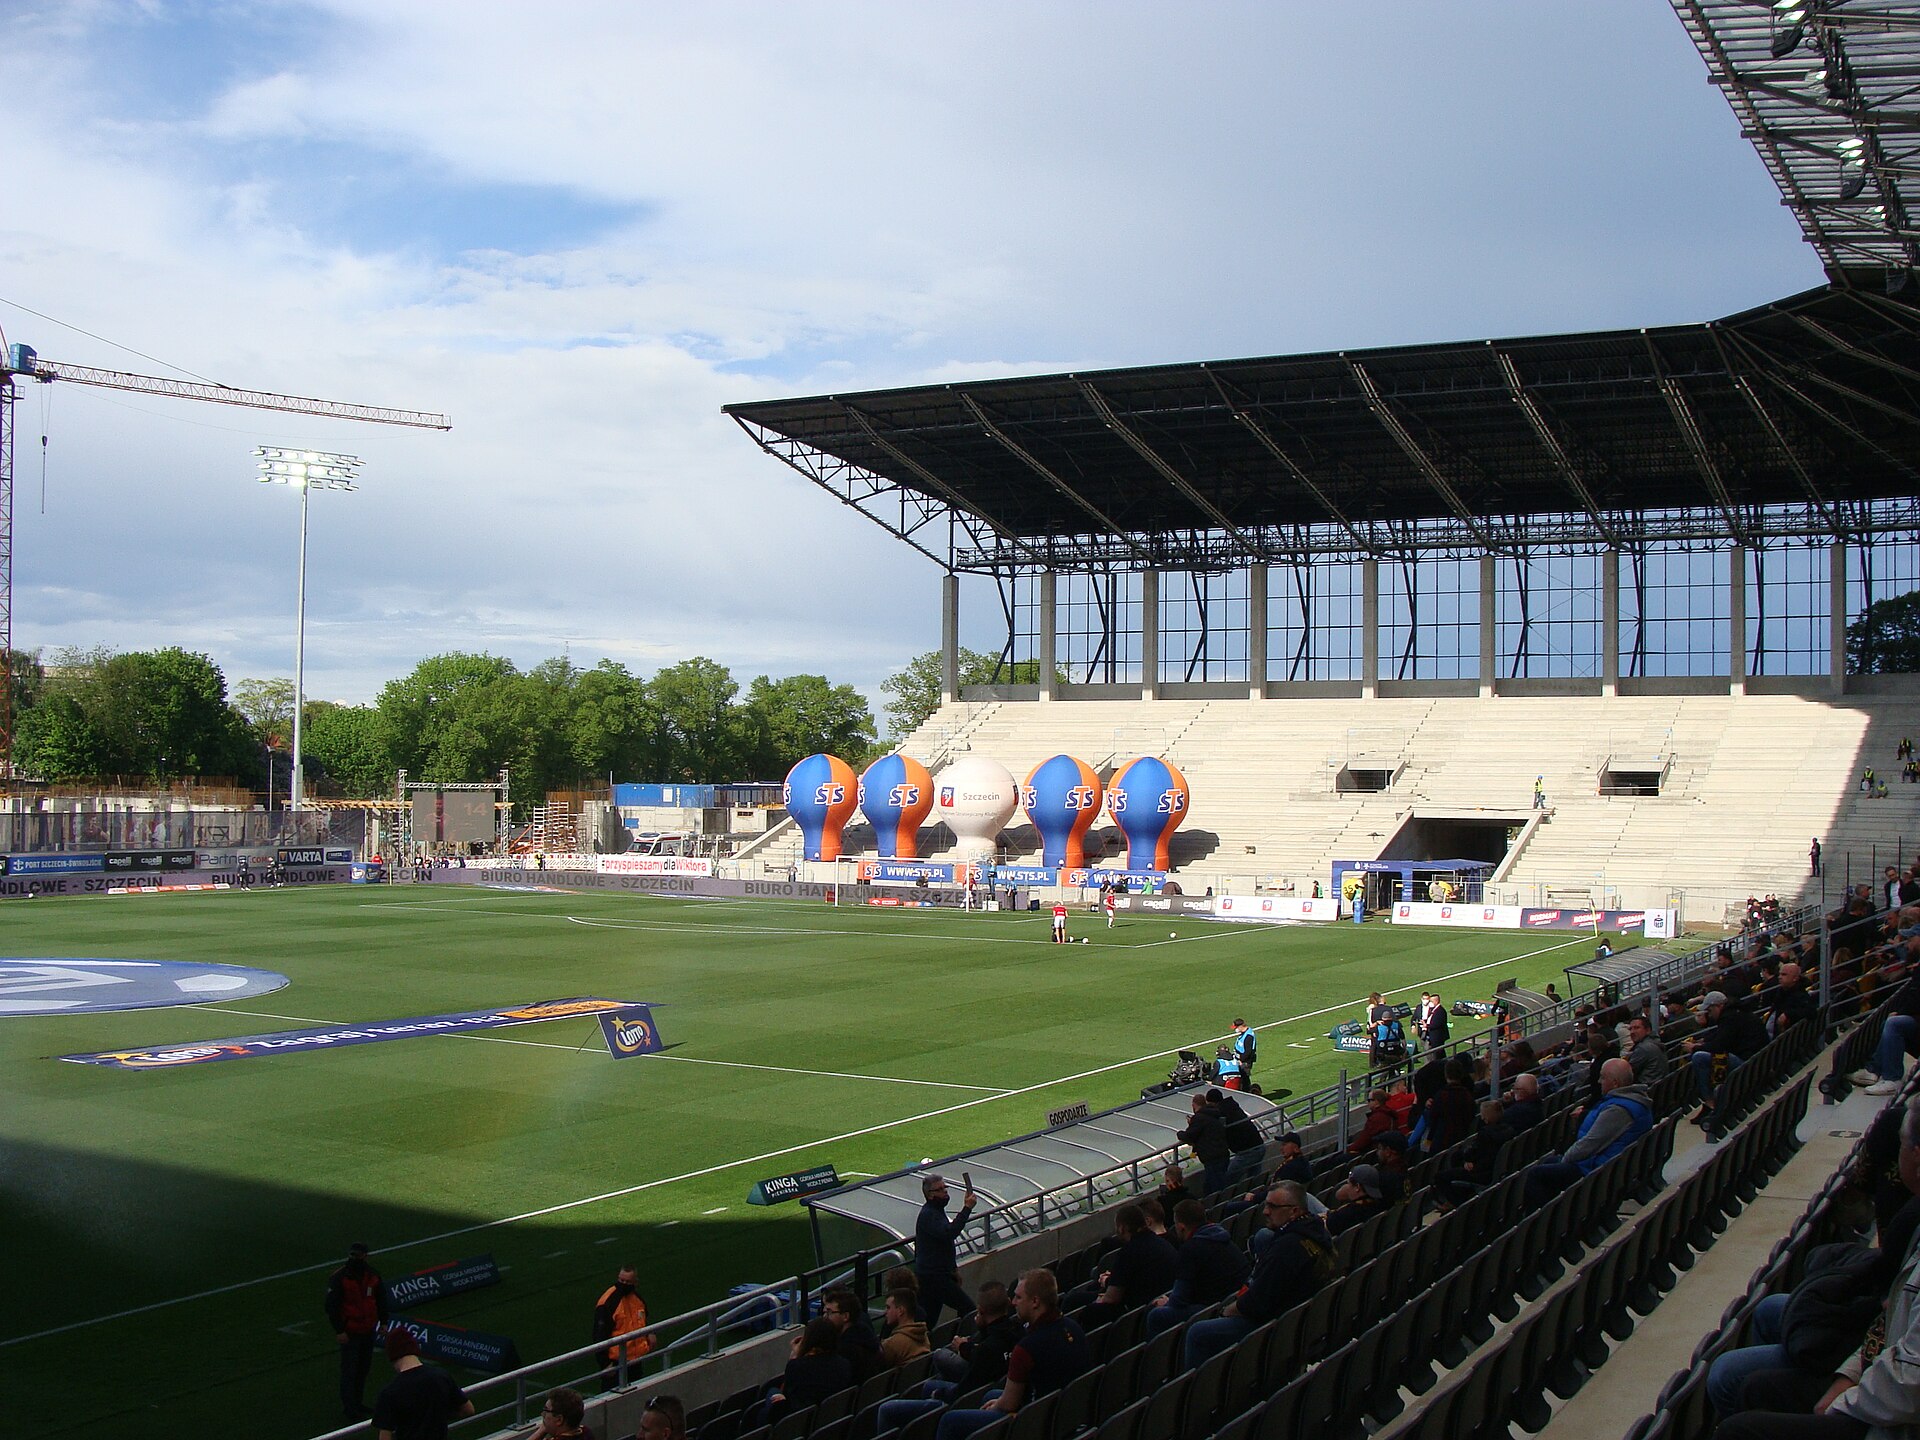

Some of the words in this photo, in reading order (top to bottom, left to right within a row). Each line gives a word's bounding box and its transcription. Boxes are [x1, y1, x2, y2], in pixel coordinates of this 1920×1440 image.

[815, 783, 844, 805] STS
[889, 784, 919, 807] STS
[962, 792, 1000, 800] Szczecin
[1022, 786, 1037, 809] TS
[1065, 786, 1094, 810] STS
[1158, 787, 1185, 813] STS
[464, 803, 487, 816] 14
[109, 856, 132, 867] capelli
[141, 856, 162, 866] capelli
[171, 855, 192, 865] capelli
[289, 851, 322, 862] VARTA
[25, 861, 40, 869] PORT
[864, 863, 882, 877] STS
[260, 871, 335, 884] HNDLOWE
[481, 871, 522, 883] BIURO
[527, 871, 605, 887] HANDLOWE
[621, 878, 694, 891] SZCZECIN
[995, 870, 1049, 881] WW.STS.PL
[85, 876, 163, 892] SZCZECIN
[745, 883, 793, 896] BIURO
[620, 1025, 643, 1045] LOTTO
[1341, 1037, 1371, 1046] KINGA
[1049, 1104, 1088, 1126] GOSPODARZE
[765, 1177, 799, 1194] KINGA
[391, 1276, 440, 1299] KINGA
[436, 1334, 463, 1347] GÓRSKA
[462, 1340, 501, 1354] MINERALNA
[441, 1345, 462, 1356] WODA
[467, 1351, 489, 1362] PIENIN
